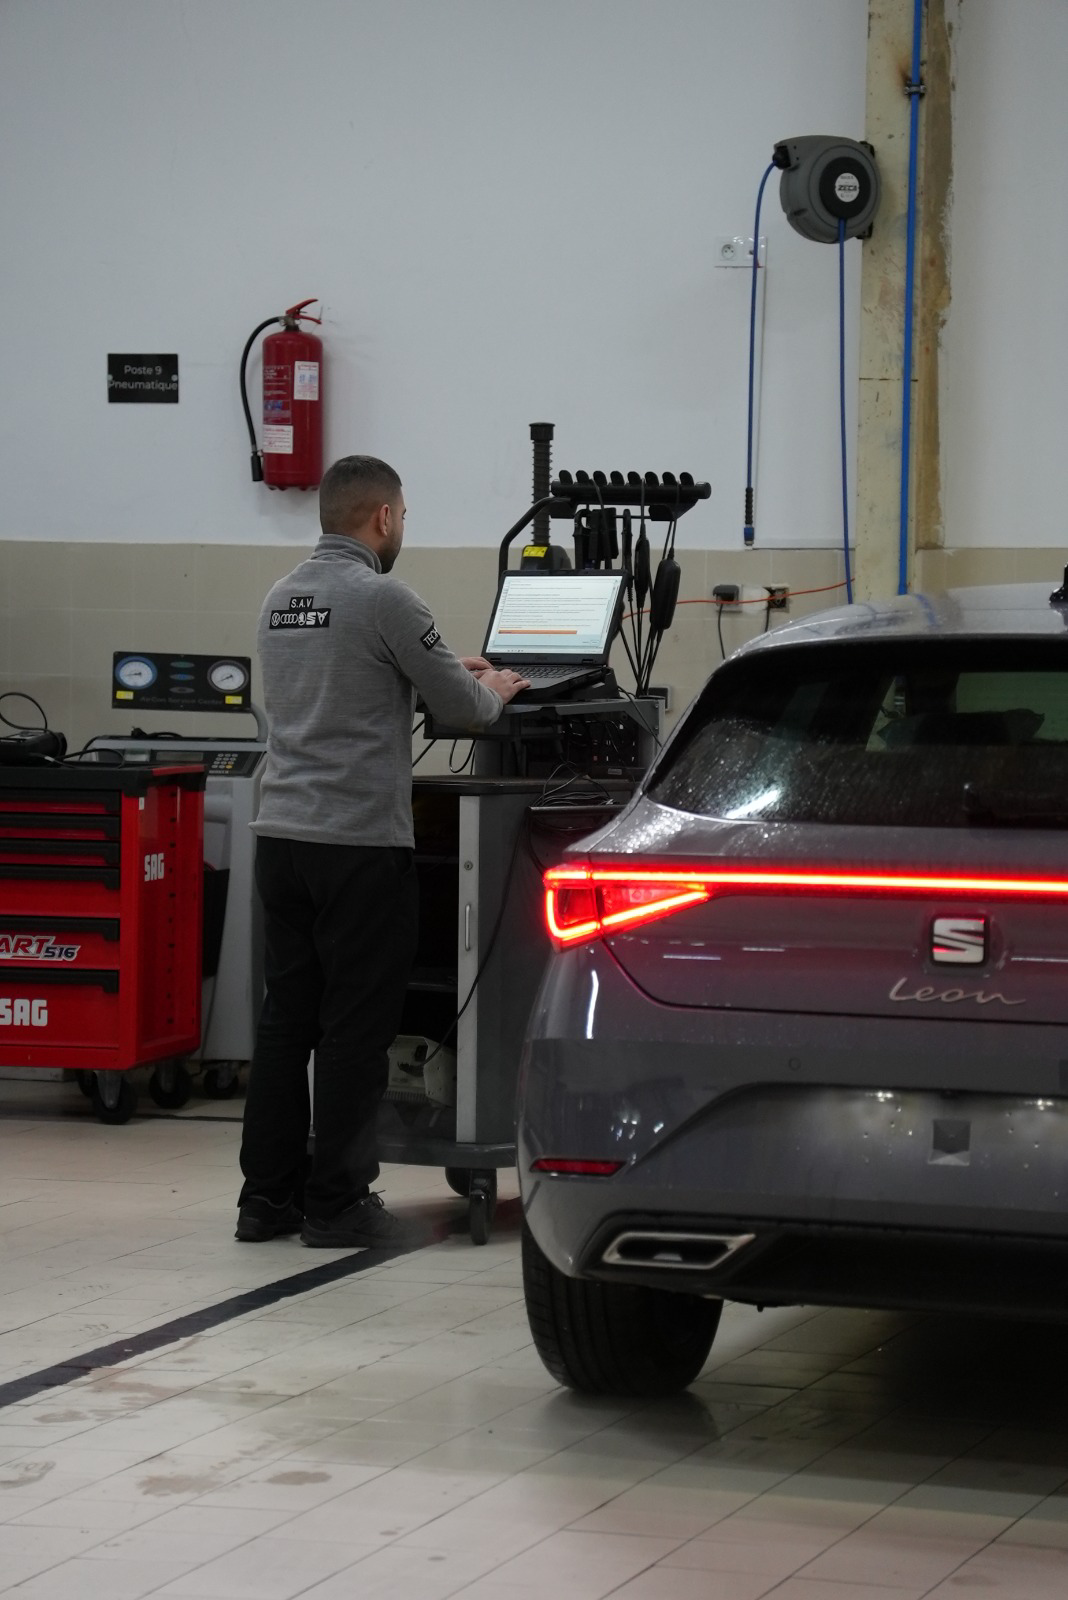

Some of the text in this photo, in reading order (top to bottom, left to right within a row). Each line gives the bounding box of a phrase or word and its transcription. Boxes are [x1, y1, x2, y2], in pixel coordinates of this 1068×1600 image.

[124, 365, 162, 375] Poste 9
[108, 379, 178, 392] Pneumatique
[290, 598, 312, 608] S.A.V
[144, 852, 165, 882] SAG
[44, 947, 77, 958] 516
[888, 977, 1026, 1005] Leon
[0, 998, 48, 1027] SAG
